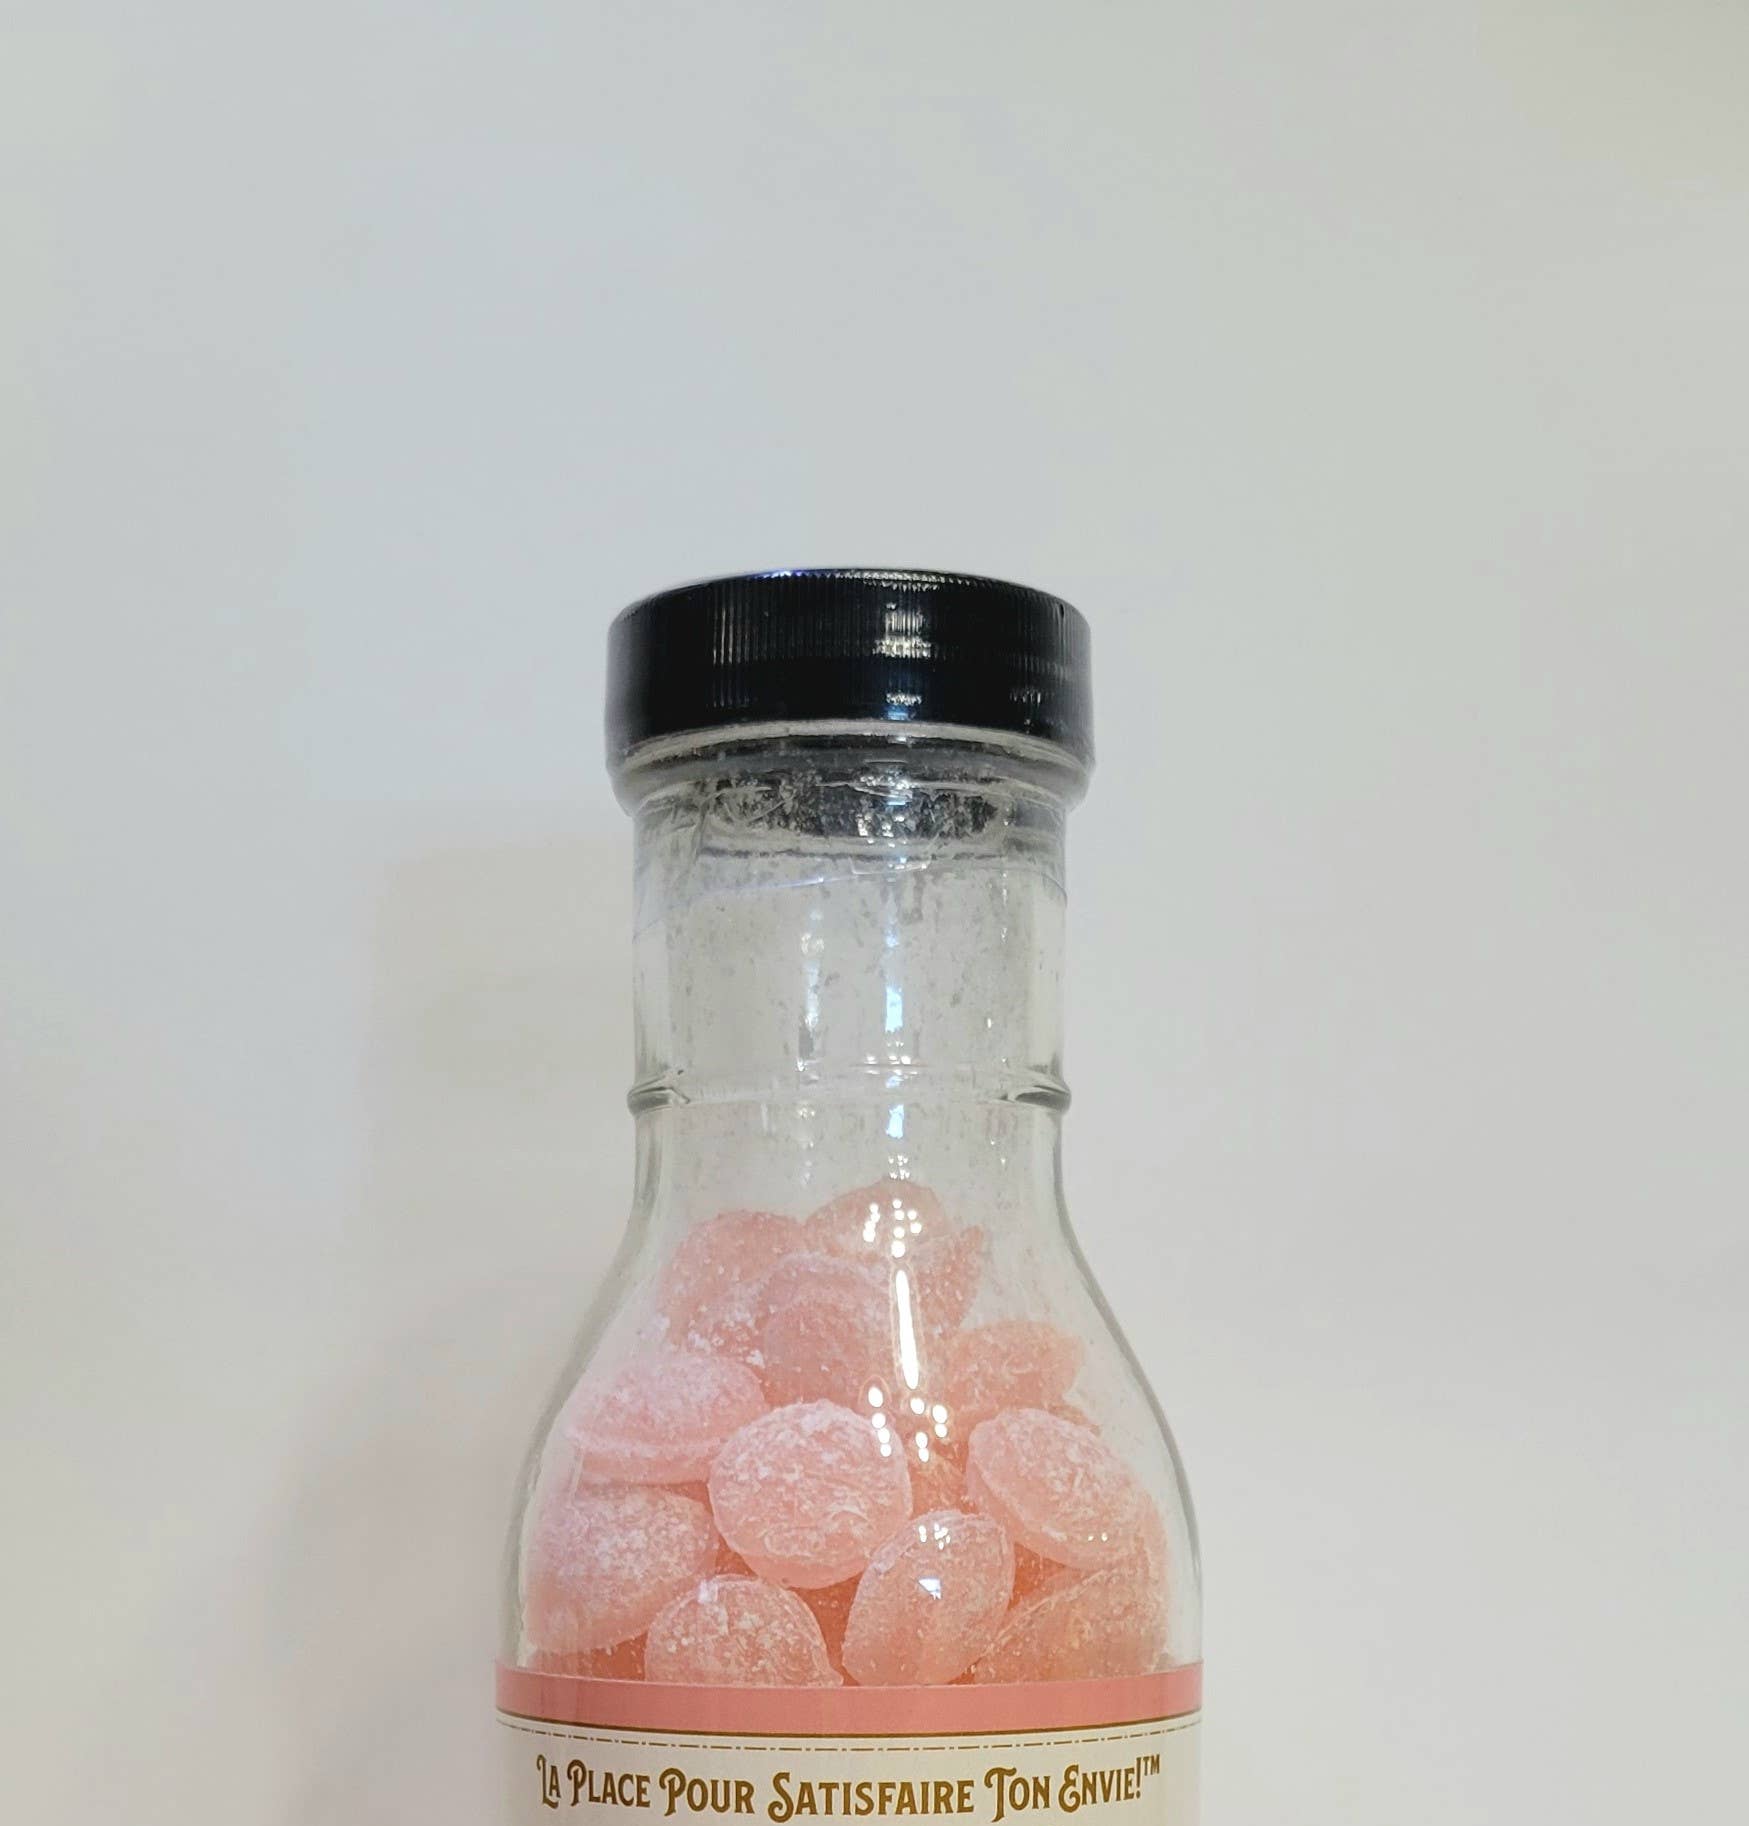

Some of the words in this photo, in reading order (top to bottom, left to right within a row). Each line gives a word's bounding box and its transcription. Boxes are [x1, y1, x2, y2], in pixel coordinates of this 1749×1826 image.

[567, 1759, 650, 1807] PLACE
[659, 1767, 755, 1817] POUR
[767, 1772, 974, 1823] SATISFAIRE
